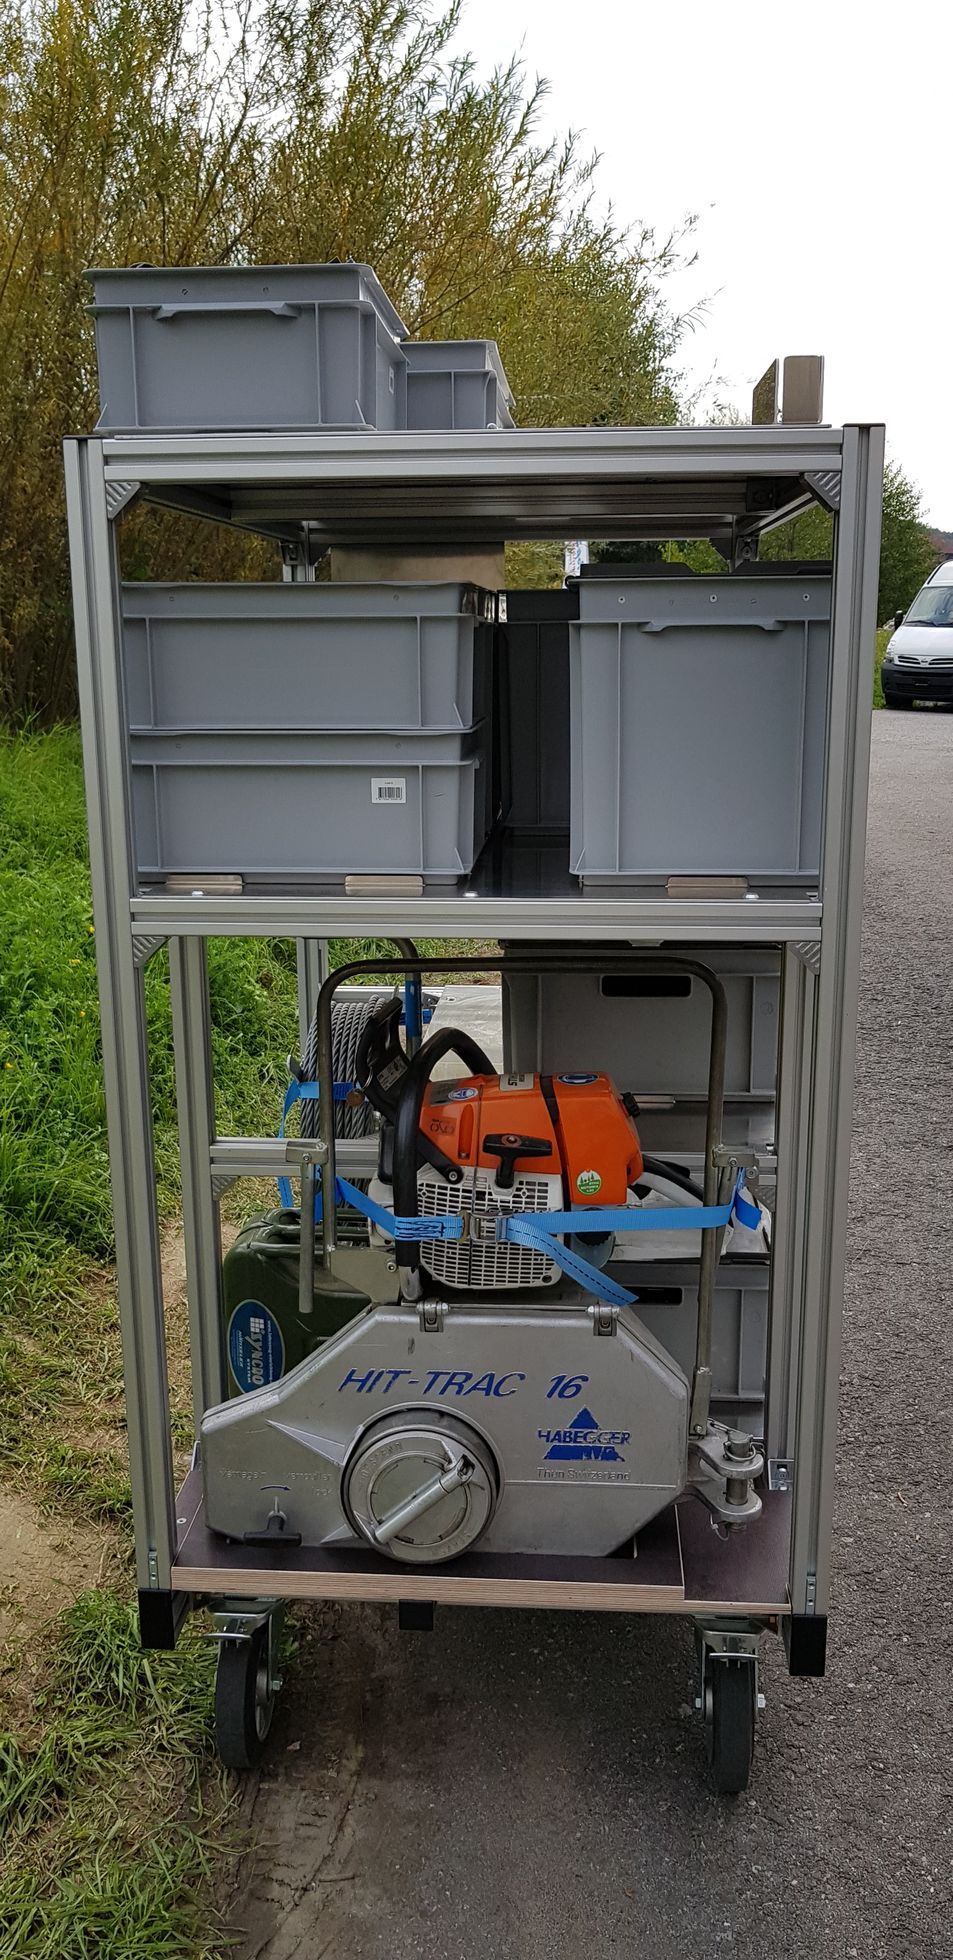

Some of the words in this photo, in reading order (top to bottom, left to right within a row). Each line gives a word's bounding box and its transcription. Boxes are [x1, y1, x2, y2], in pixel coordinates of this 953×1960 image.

[337, 1367, 528, 1398] HIT-TRAC
[545, 1373, 589, 1399] 16
[537, 1428, 631, 1445] HABEGGER
[537, 1467, 565, 1480] Thun
[567, 1468, 631, 1481] Switzerland
